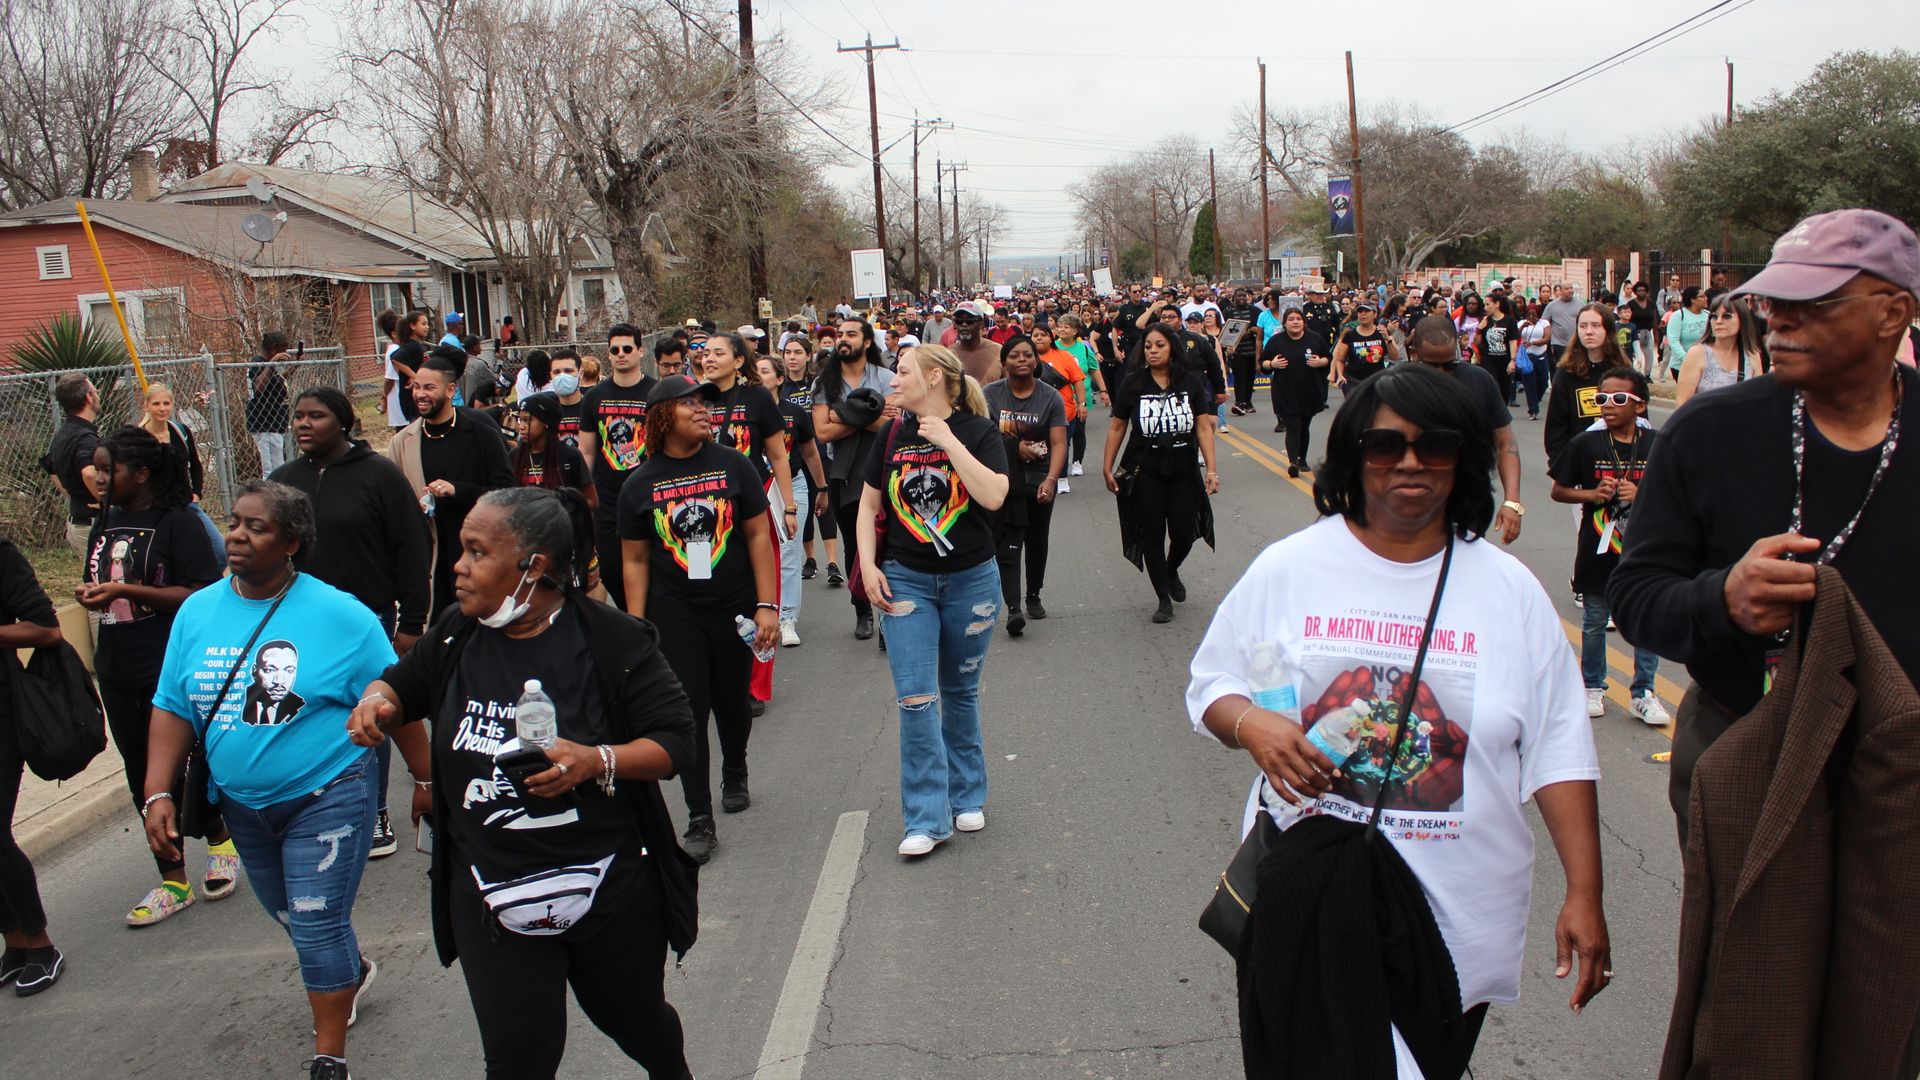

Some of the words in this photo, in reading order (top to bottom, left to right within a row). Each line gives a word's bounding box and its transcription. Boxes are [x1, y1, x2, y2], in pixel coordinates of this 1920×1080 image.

[1000, 412, 1039, 423] MELANIN
[1139, 411, 1195, 435] VOTERS
[1401, 614, 1430, 623] ANTON
[1304, 616, 1323, 638] DR.
[1326, 617, 1374, 642] MARTIN
[1376, 621, 1423, 648] LUTHER
[1461, 631, 1478, 655] JR.
[206, 647, 228, 656] MLK
[230, 647, 249, 657] DA
[1319, 644, 1352, 654] ANNUAL
[1427, 656, 1458, 667] MARCH
[1459, 659, 1478, 669] 2023
[194, 671, 215, 679] BEGIN
[217, 671, 229, 679] TO
[1371, 665, 1401, 685] NO
[199, 683, 215, 691] THE
[233, 682, 245, 690] WE
[475, 717, 507, 739] His
[1313, 799, 1351, 818] TOGETHER
[1351, 808, 1364, 822] WE
[1384, 815, 1396, 827] BE
[1399, 817, 1415, 829] THE
[1417, 818, 1447, 830] DREAM
